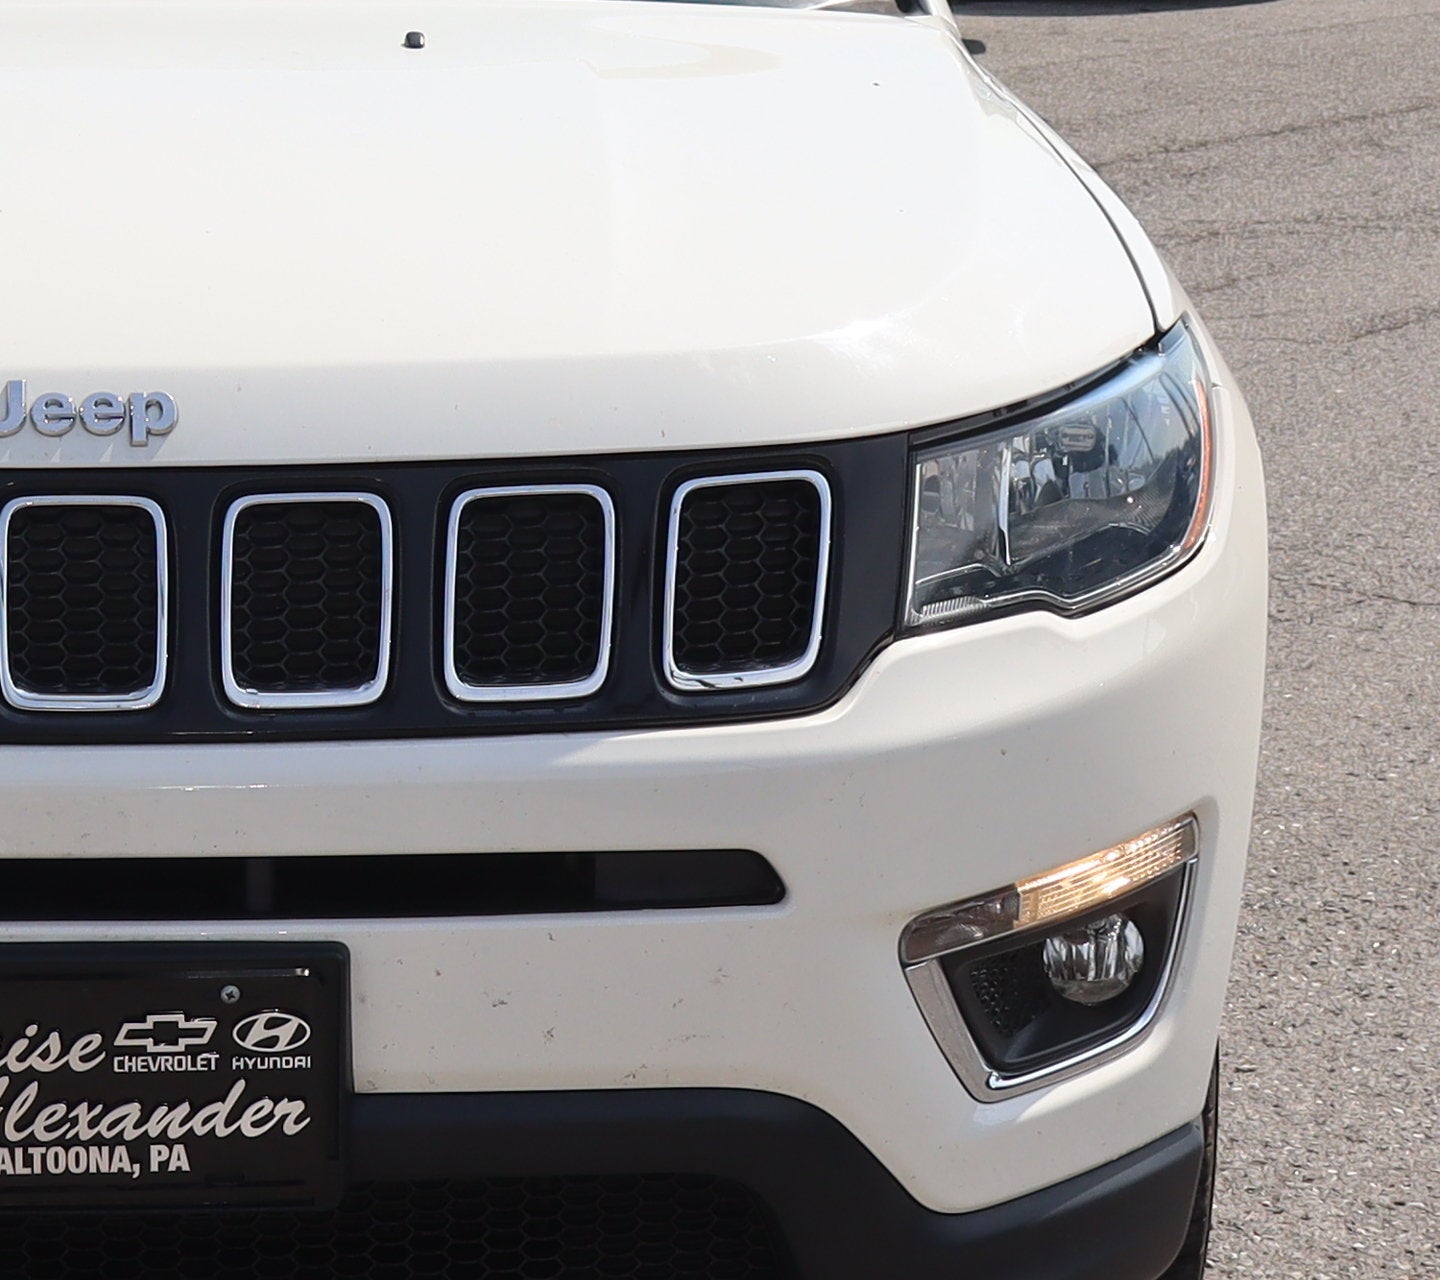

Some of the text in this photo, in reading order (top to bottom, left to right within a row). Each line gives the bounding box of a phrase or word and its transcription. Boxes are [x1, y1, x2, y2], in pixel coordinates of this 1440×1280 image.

[113, 1052, 312, 1073] CHEVROLET HYUNDAI
[149, 1144, 191, 1173] PA
